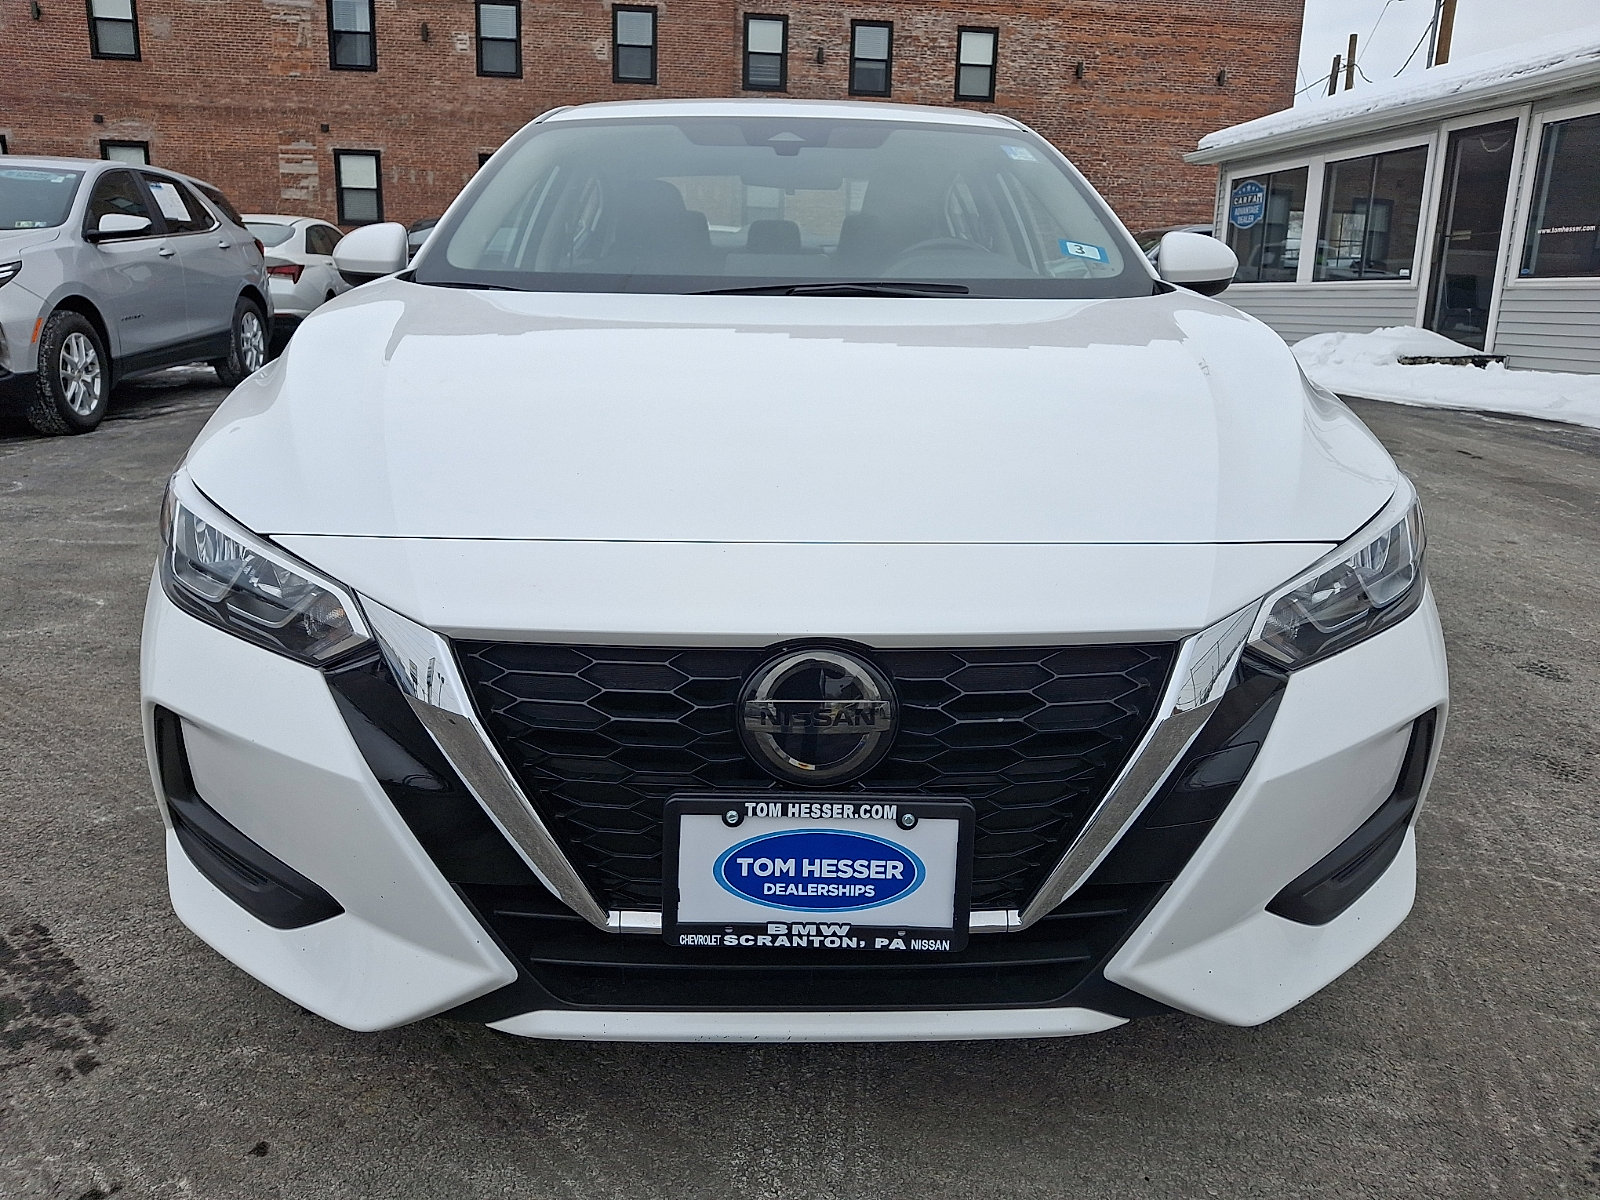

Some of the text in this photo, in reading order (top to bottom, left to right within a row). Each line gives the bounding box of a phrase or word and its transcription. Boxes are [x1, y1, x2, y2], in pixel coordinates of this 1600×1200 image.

[1537, 226, 1596, 234] www.tomhesser.com
[1074, 245, 1085, 254] 3
[760, 708, 876, 726] NISSAN
[745, 802, 898, 820] TOM HESSER.COM
[736, 858, 904, 880] TOM HESSER
[763, 883, 876, 898] DEALERSHIPS
[767, 923, 850, 937] BMW
[679, 934, 951, 951] CHEVROLET SCRANTON, PA NISSAN
